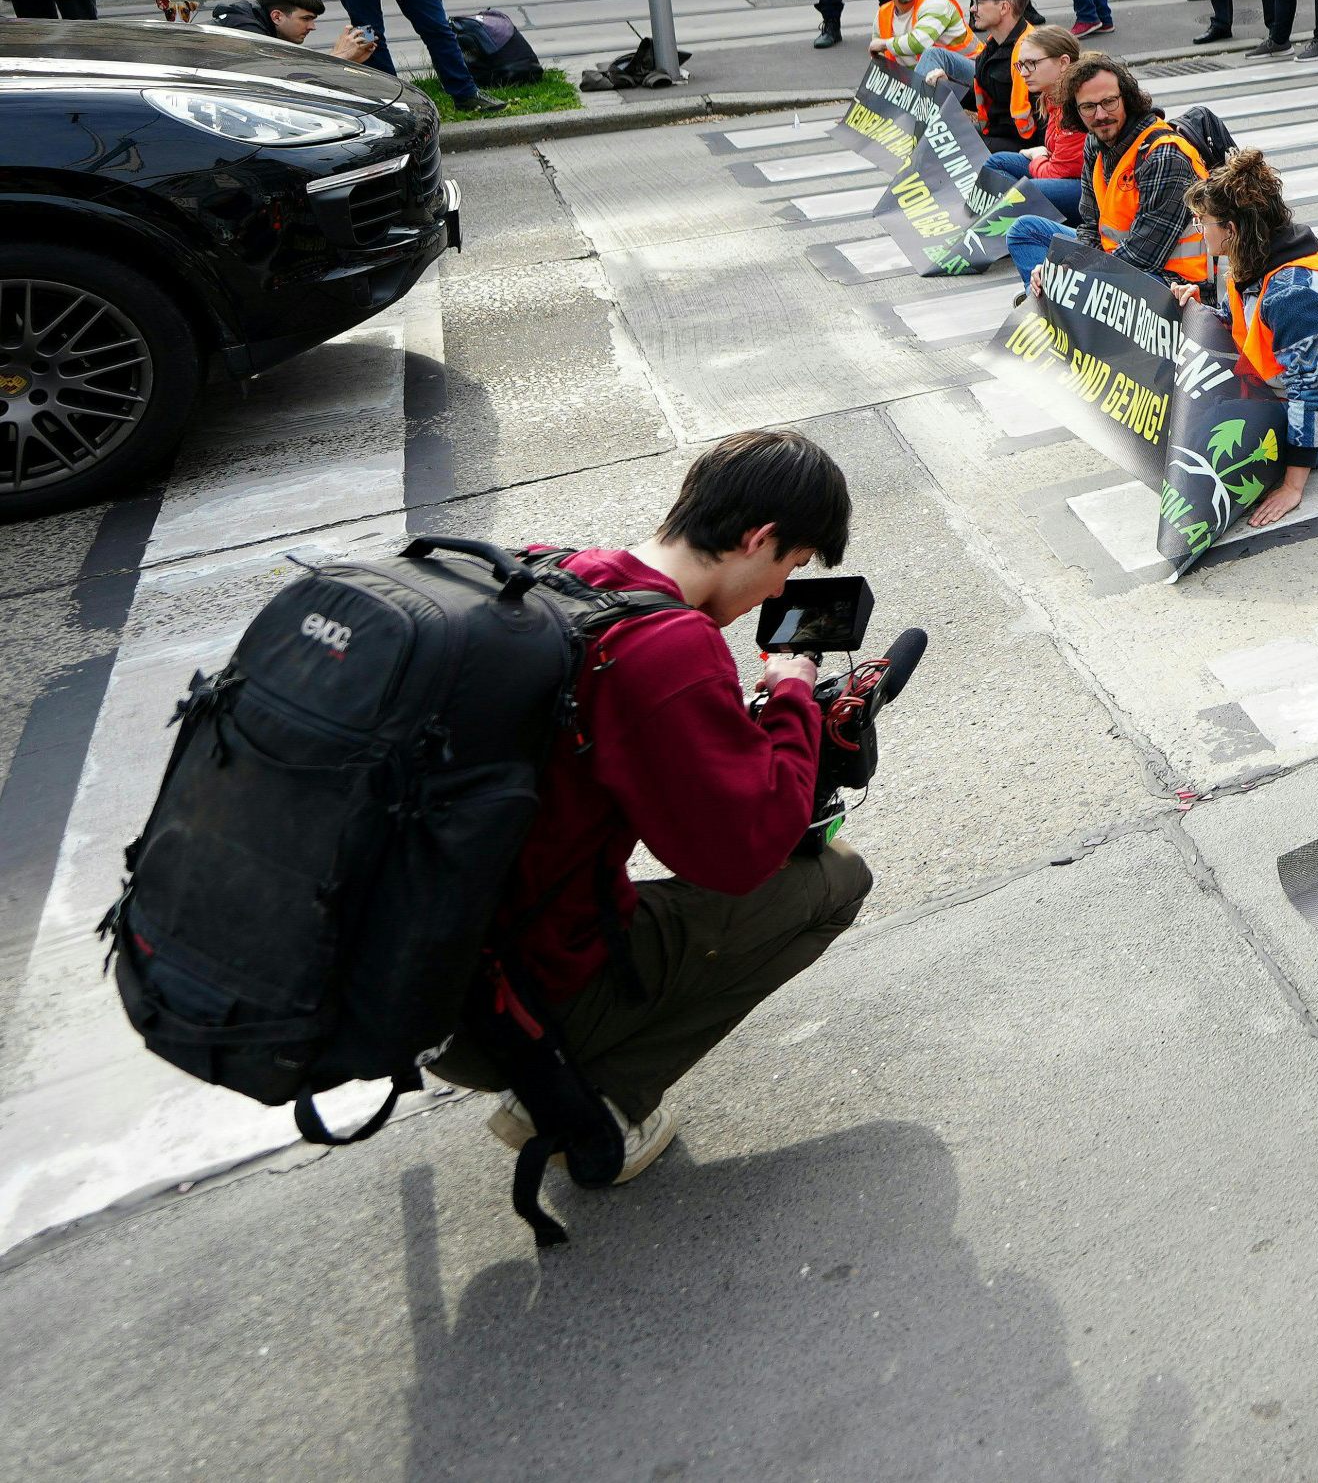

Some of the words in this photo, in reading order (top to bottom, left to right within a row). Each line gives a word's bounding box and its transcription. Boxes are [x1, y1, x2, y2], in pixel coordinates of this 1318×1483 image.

[865, 65, 889, 96] UND
[884, 78, 916, 112] WENN
[943, 154, 972, 178] IN
[891, 171, 939, 220] VOM
[1082, 278, 1137, 338] NEUEN
[1004, 311, 1056, 364] 100
[1061, 347, 1111, 403] SIND
[1100, 371, 1169, 445] GENUG!
